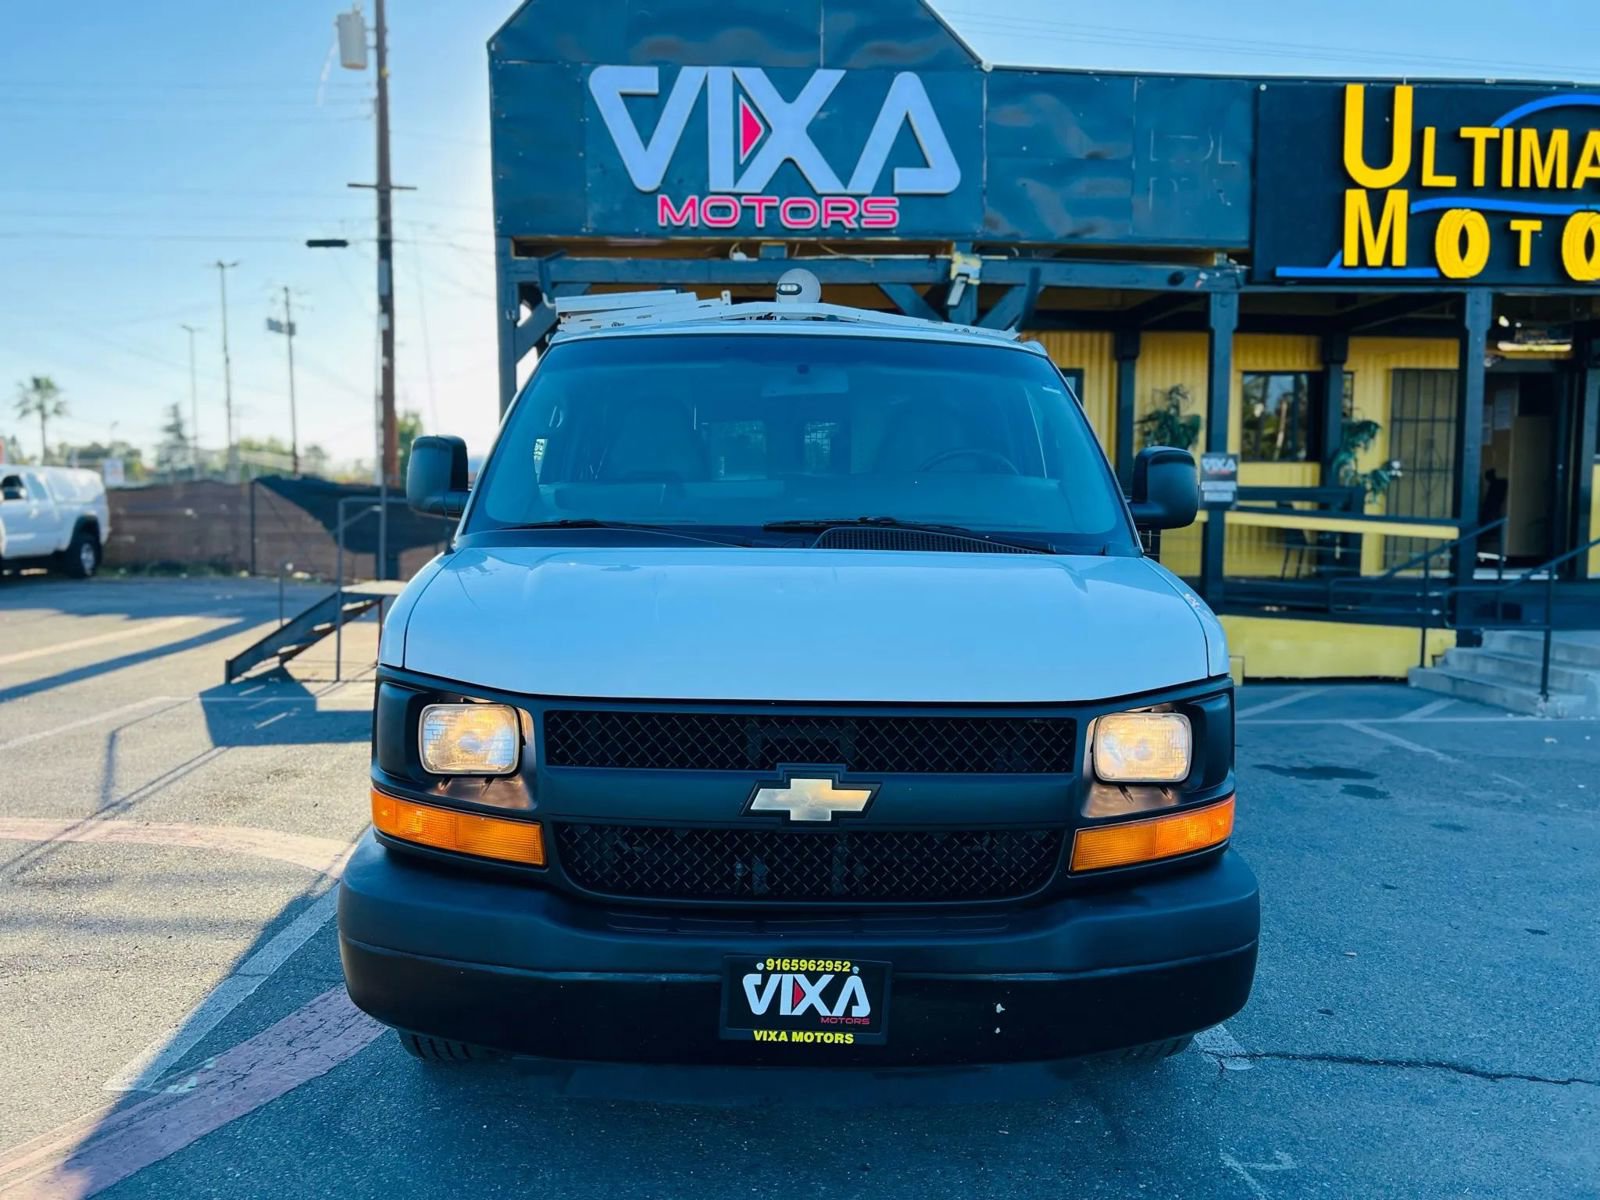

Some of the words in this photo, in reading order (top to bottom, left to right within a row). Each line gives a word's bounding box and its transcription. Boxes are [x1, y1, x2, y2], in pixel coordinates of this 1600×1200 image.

[589, 65, 961, 195] VIXA
[658, 194, 900, 229] MOTORS
[766, 958, 851, 973] 9165962952
[742, 974, 871, 1017] VIXA
[820, 1016, 870, 1025] MOTORS
[753, 1030, 788, 1042] VIXA
[791, 1030, 854, 1044] MOTORS
